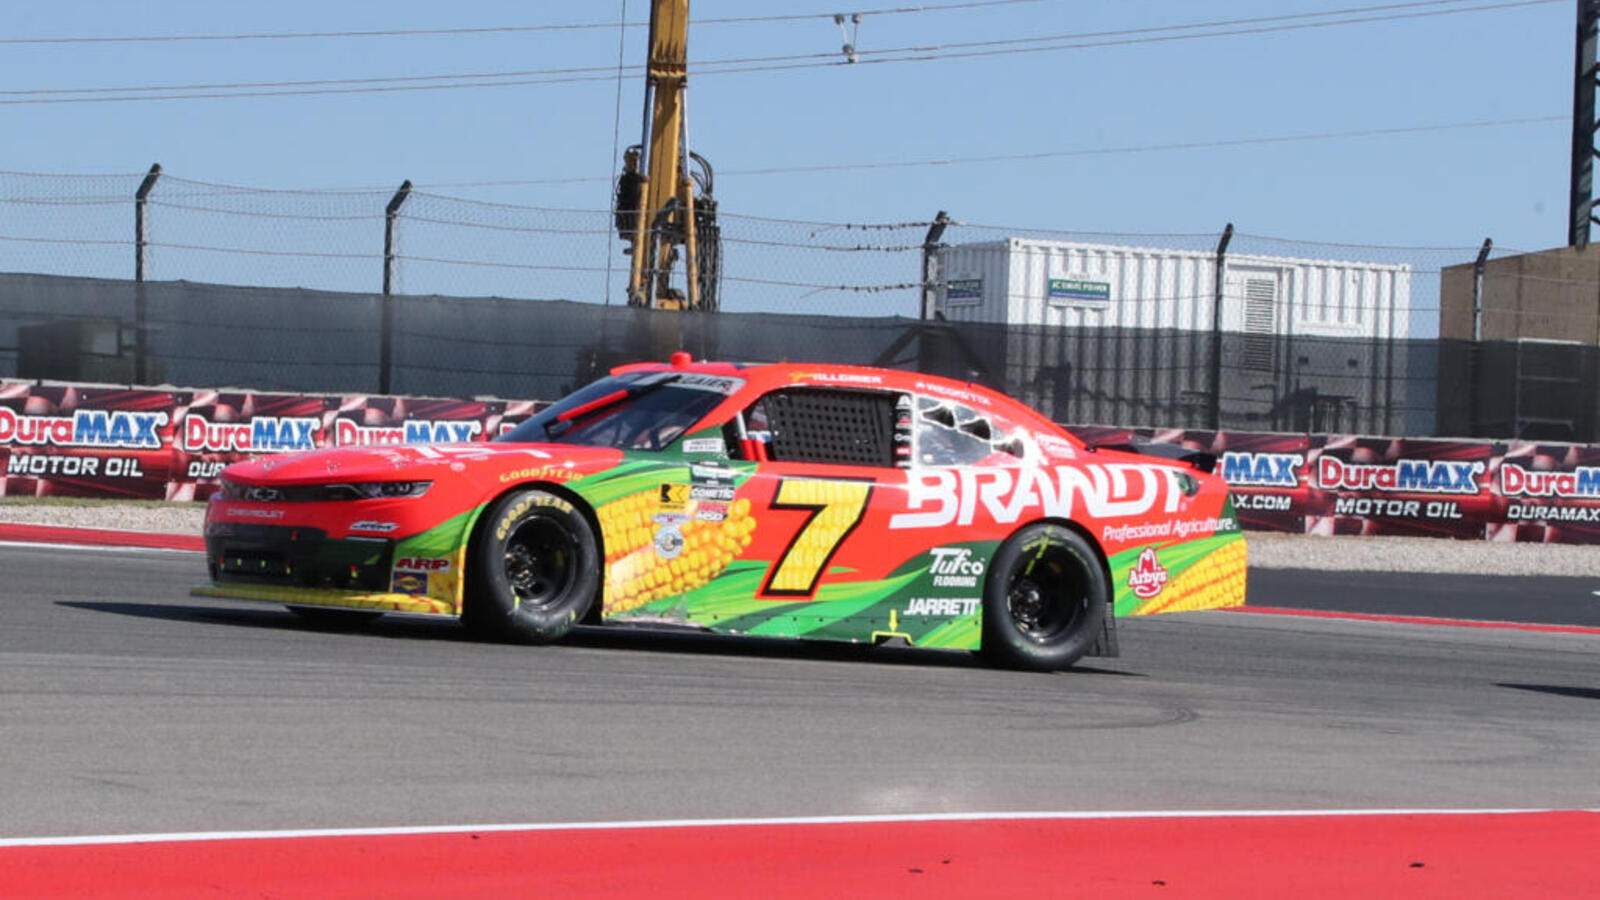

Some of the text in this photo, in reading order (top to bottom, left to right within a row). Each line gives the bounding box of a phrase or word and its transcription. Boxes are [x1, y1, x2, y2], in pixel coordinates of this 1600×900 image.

[0, 407, 163, 449] DuraMAX
[185, 415, 315, 451] DuraMAX
[8, 455, 143, 477] MOTOR OIL
[1319, 455, 1479, 494] DuraMAX
[1501, 464, 1600, 498] DuraM
[890, 464, 1183, 529] BRANDT
[1335, 498, 1463, 518] MOTOR OIL
[1508, 504, 1600, 522] DURAMAX
[761, 475, 876, 598] 7
[1103, 517, 1233, 542] Professional Agriculture
[395, 557, 450, 571] ARP
[929, 547, 984, 576] Tufco
[933, 576, 977, 588] FLOORING
[1129, 565, 1167, 587] Arby's
[902, 597, 981, 616] JARRETT
